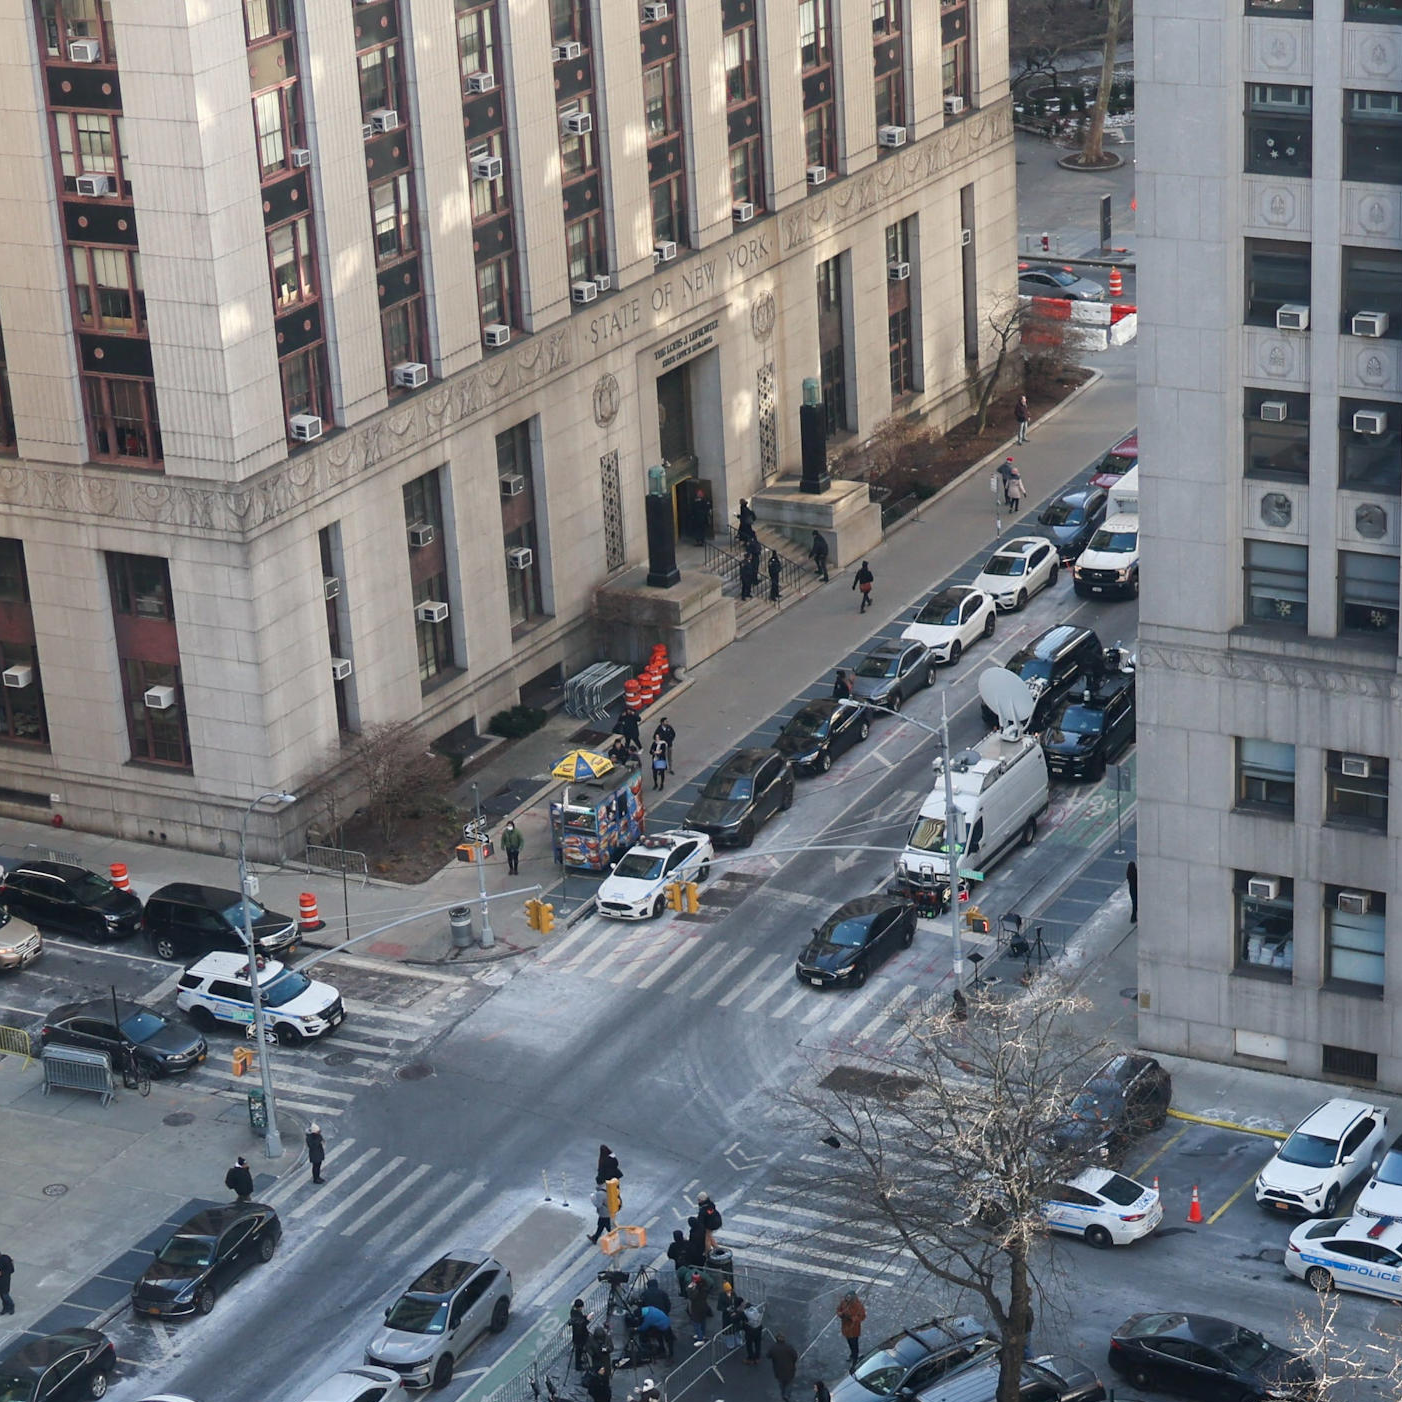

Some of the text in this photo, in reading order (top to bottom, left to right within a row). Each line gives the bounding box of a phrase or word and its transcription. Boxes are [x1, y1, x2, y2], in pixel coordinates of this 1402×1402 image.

[590, 234, 770, 344] STATE OF NEW YORK
[1348, 1264, 1401, 1283] POLICE
